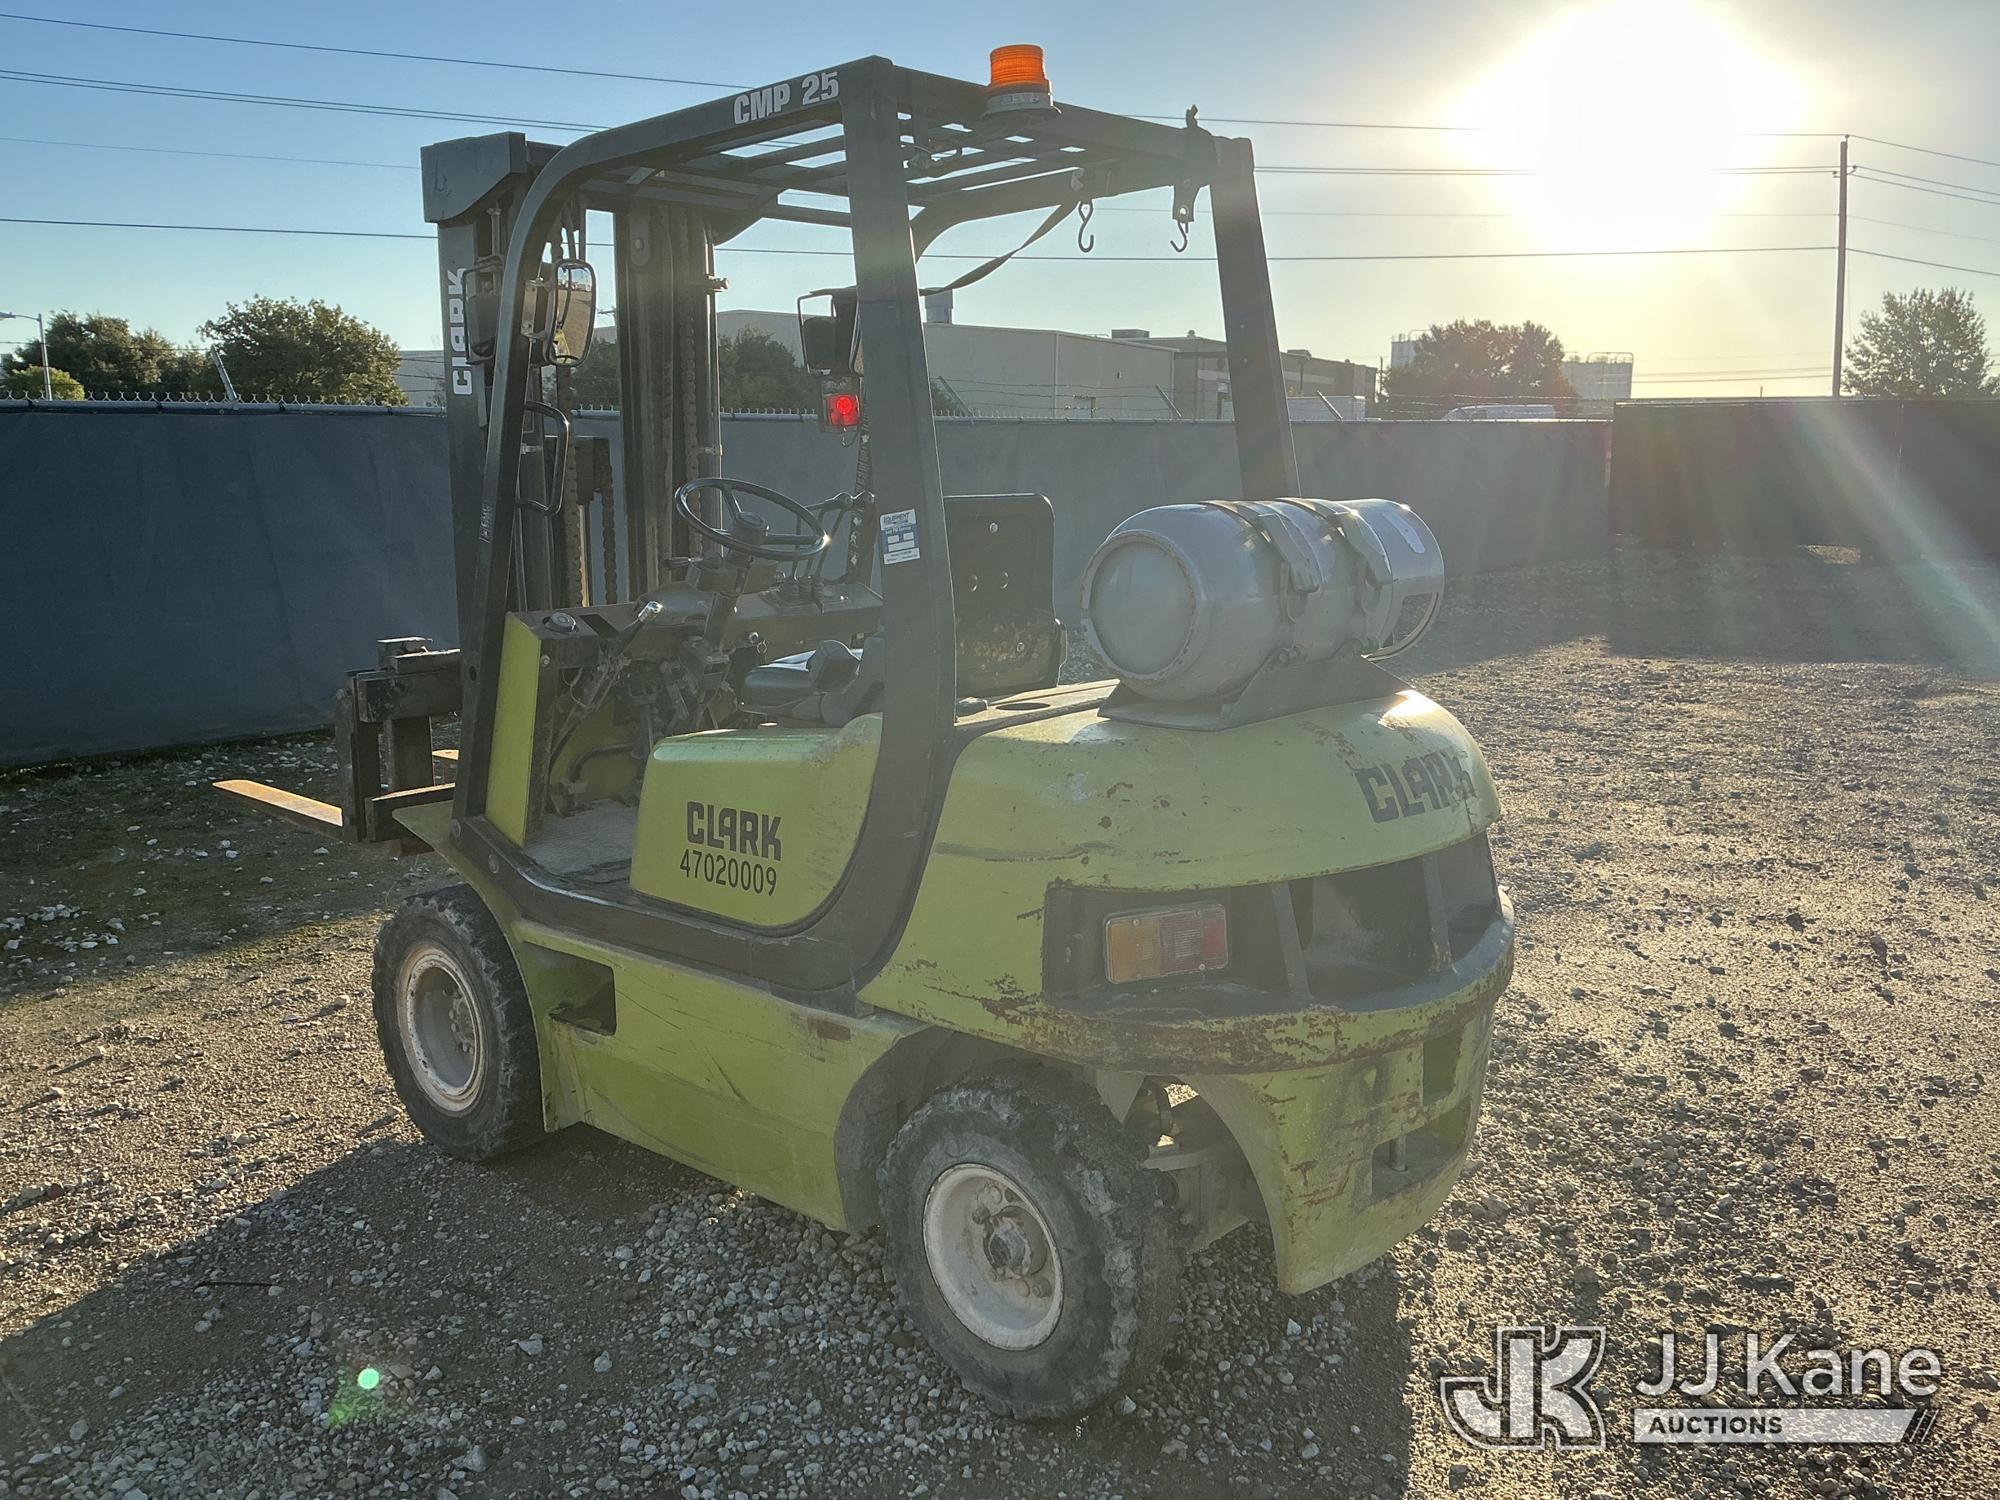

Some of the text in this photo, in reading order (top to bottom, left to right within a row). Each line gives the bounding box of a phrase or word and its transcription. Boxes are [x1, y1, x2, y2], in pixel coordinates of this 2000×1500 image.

[734, 71, 839, 124] CMP 25
[447, 268, 473, 395] CLARK
[687, 801, 782, 861] CLARK
[680, 849, 777, 896] 47020009
